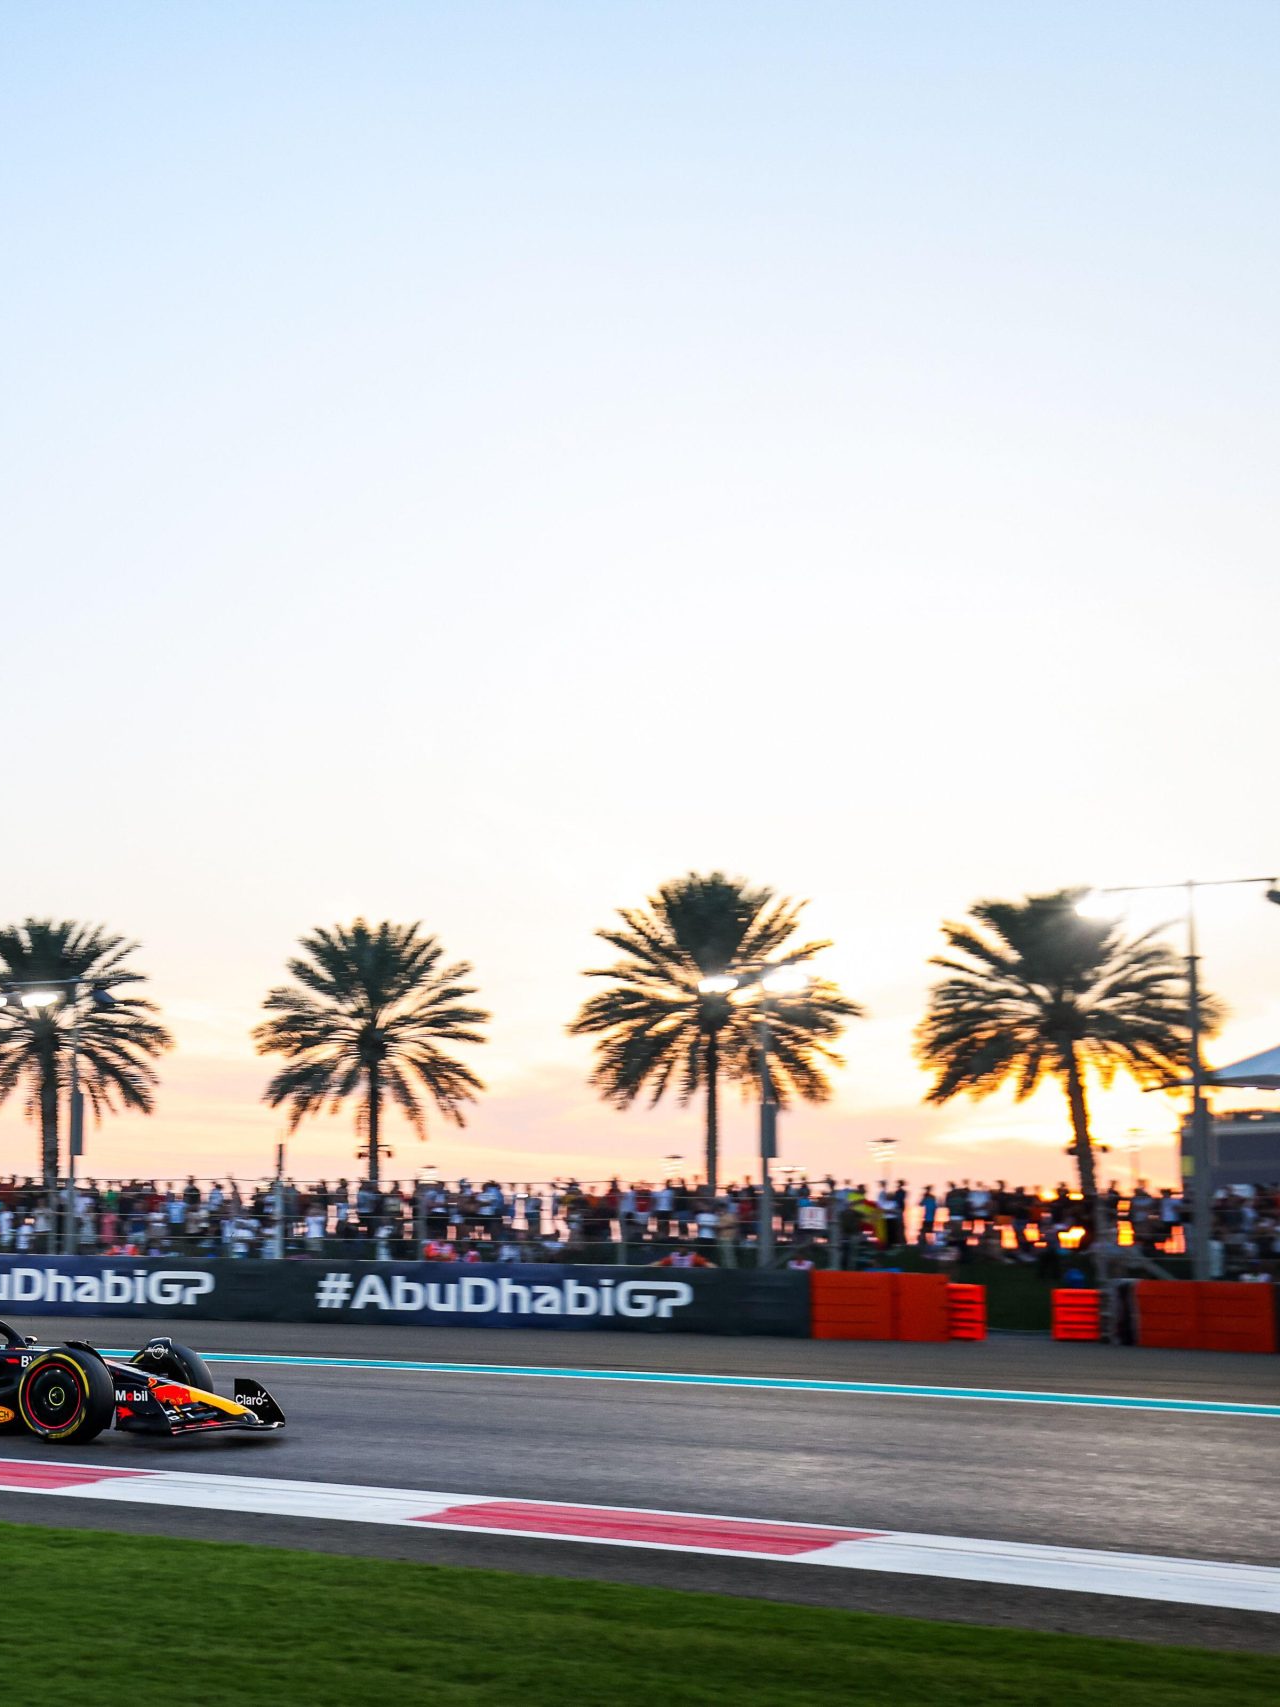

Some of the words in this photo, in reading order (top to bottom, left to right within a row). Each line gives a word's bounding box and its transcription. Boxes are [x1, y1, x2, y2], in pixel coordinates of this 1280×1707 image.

[315, 1271, 694, 1318] #AbuDhabiGP
[115, 1389, 148, 1402] Mobil
[235, 1393, 263, 1406] Claro
